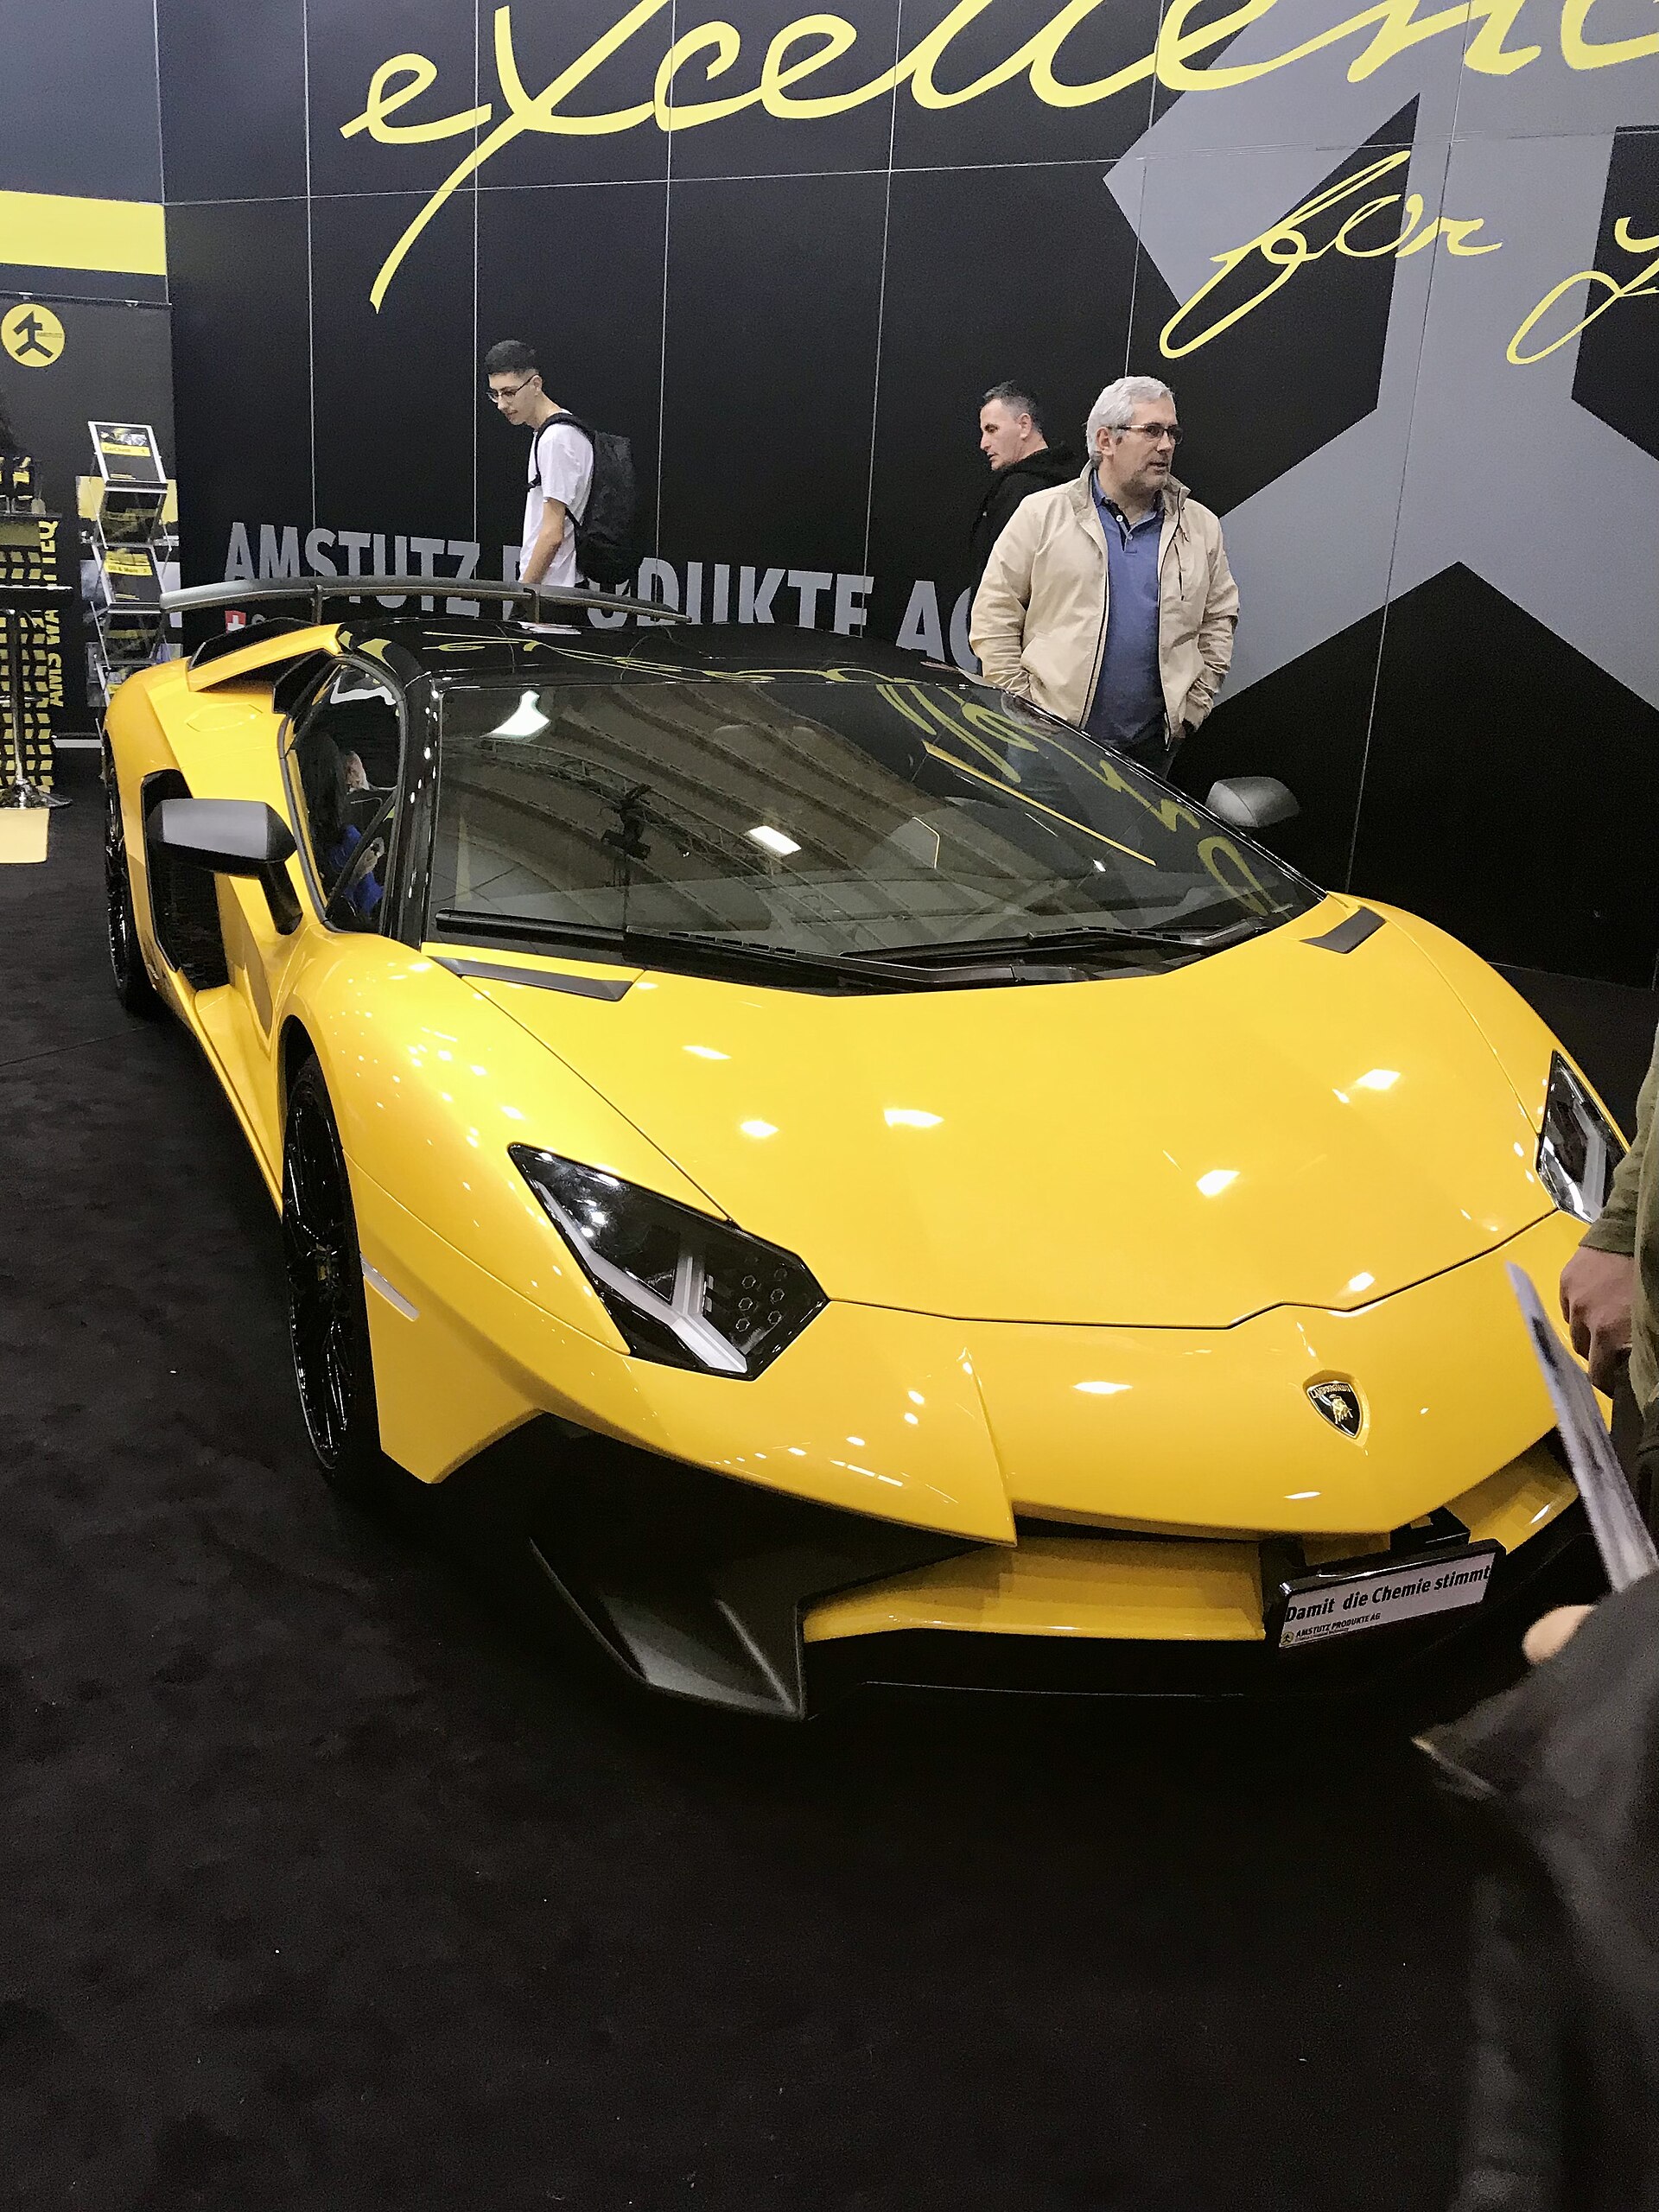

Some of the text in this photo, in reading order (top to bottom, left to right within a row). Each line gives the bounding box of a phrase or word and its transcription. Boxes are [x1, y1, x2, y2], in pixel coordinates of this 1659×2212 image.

[1160, 150, 1502, 359] for
[224, 522, 480, 617] AMSTUTZ
[1284, 1564, 1492, 1623] Damit die Chemie stimmt
[1296, 1624, 1332, 1637] AMSTUTZ
[1332, 1615, 1370, 1630] PRODUKTE
[1370, 1612, 1382, 1622] AG
